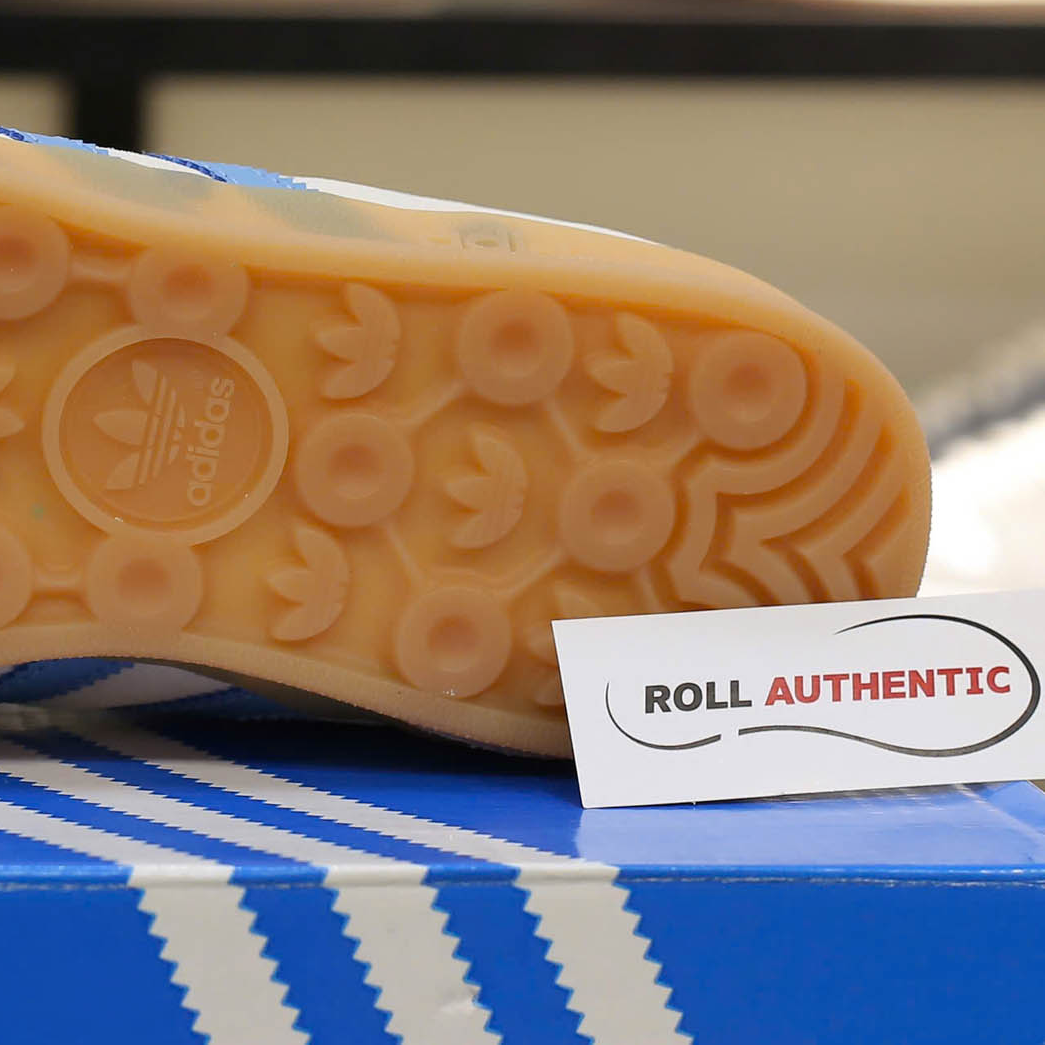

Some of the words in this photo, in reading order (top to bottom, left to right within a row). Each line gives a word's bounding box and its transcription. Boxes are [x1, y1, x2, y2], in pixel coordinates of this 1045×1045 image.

[186, 378, 235, 506] adidas
[644, 680, 752, 714] ROLL
[765, 666, 1011, 706] AUTHENTIC
